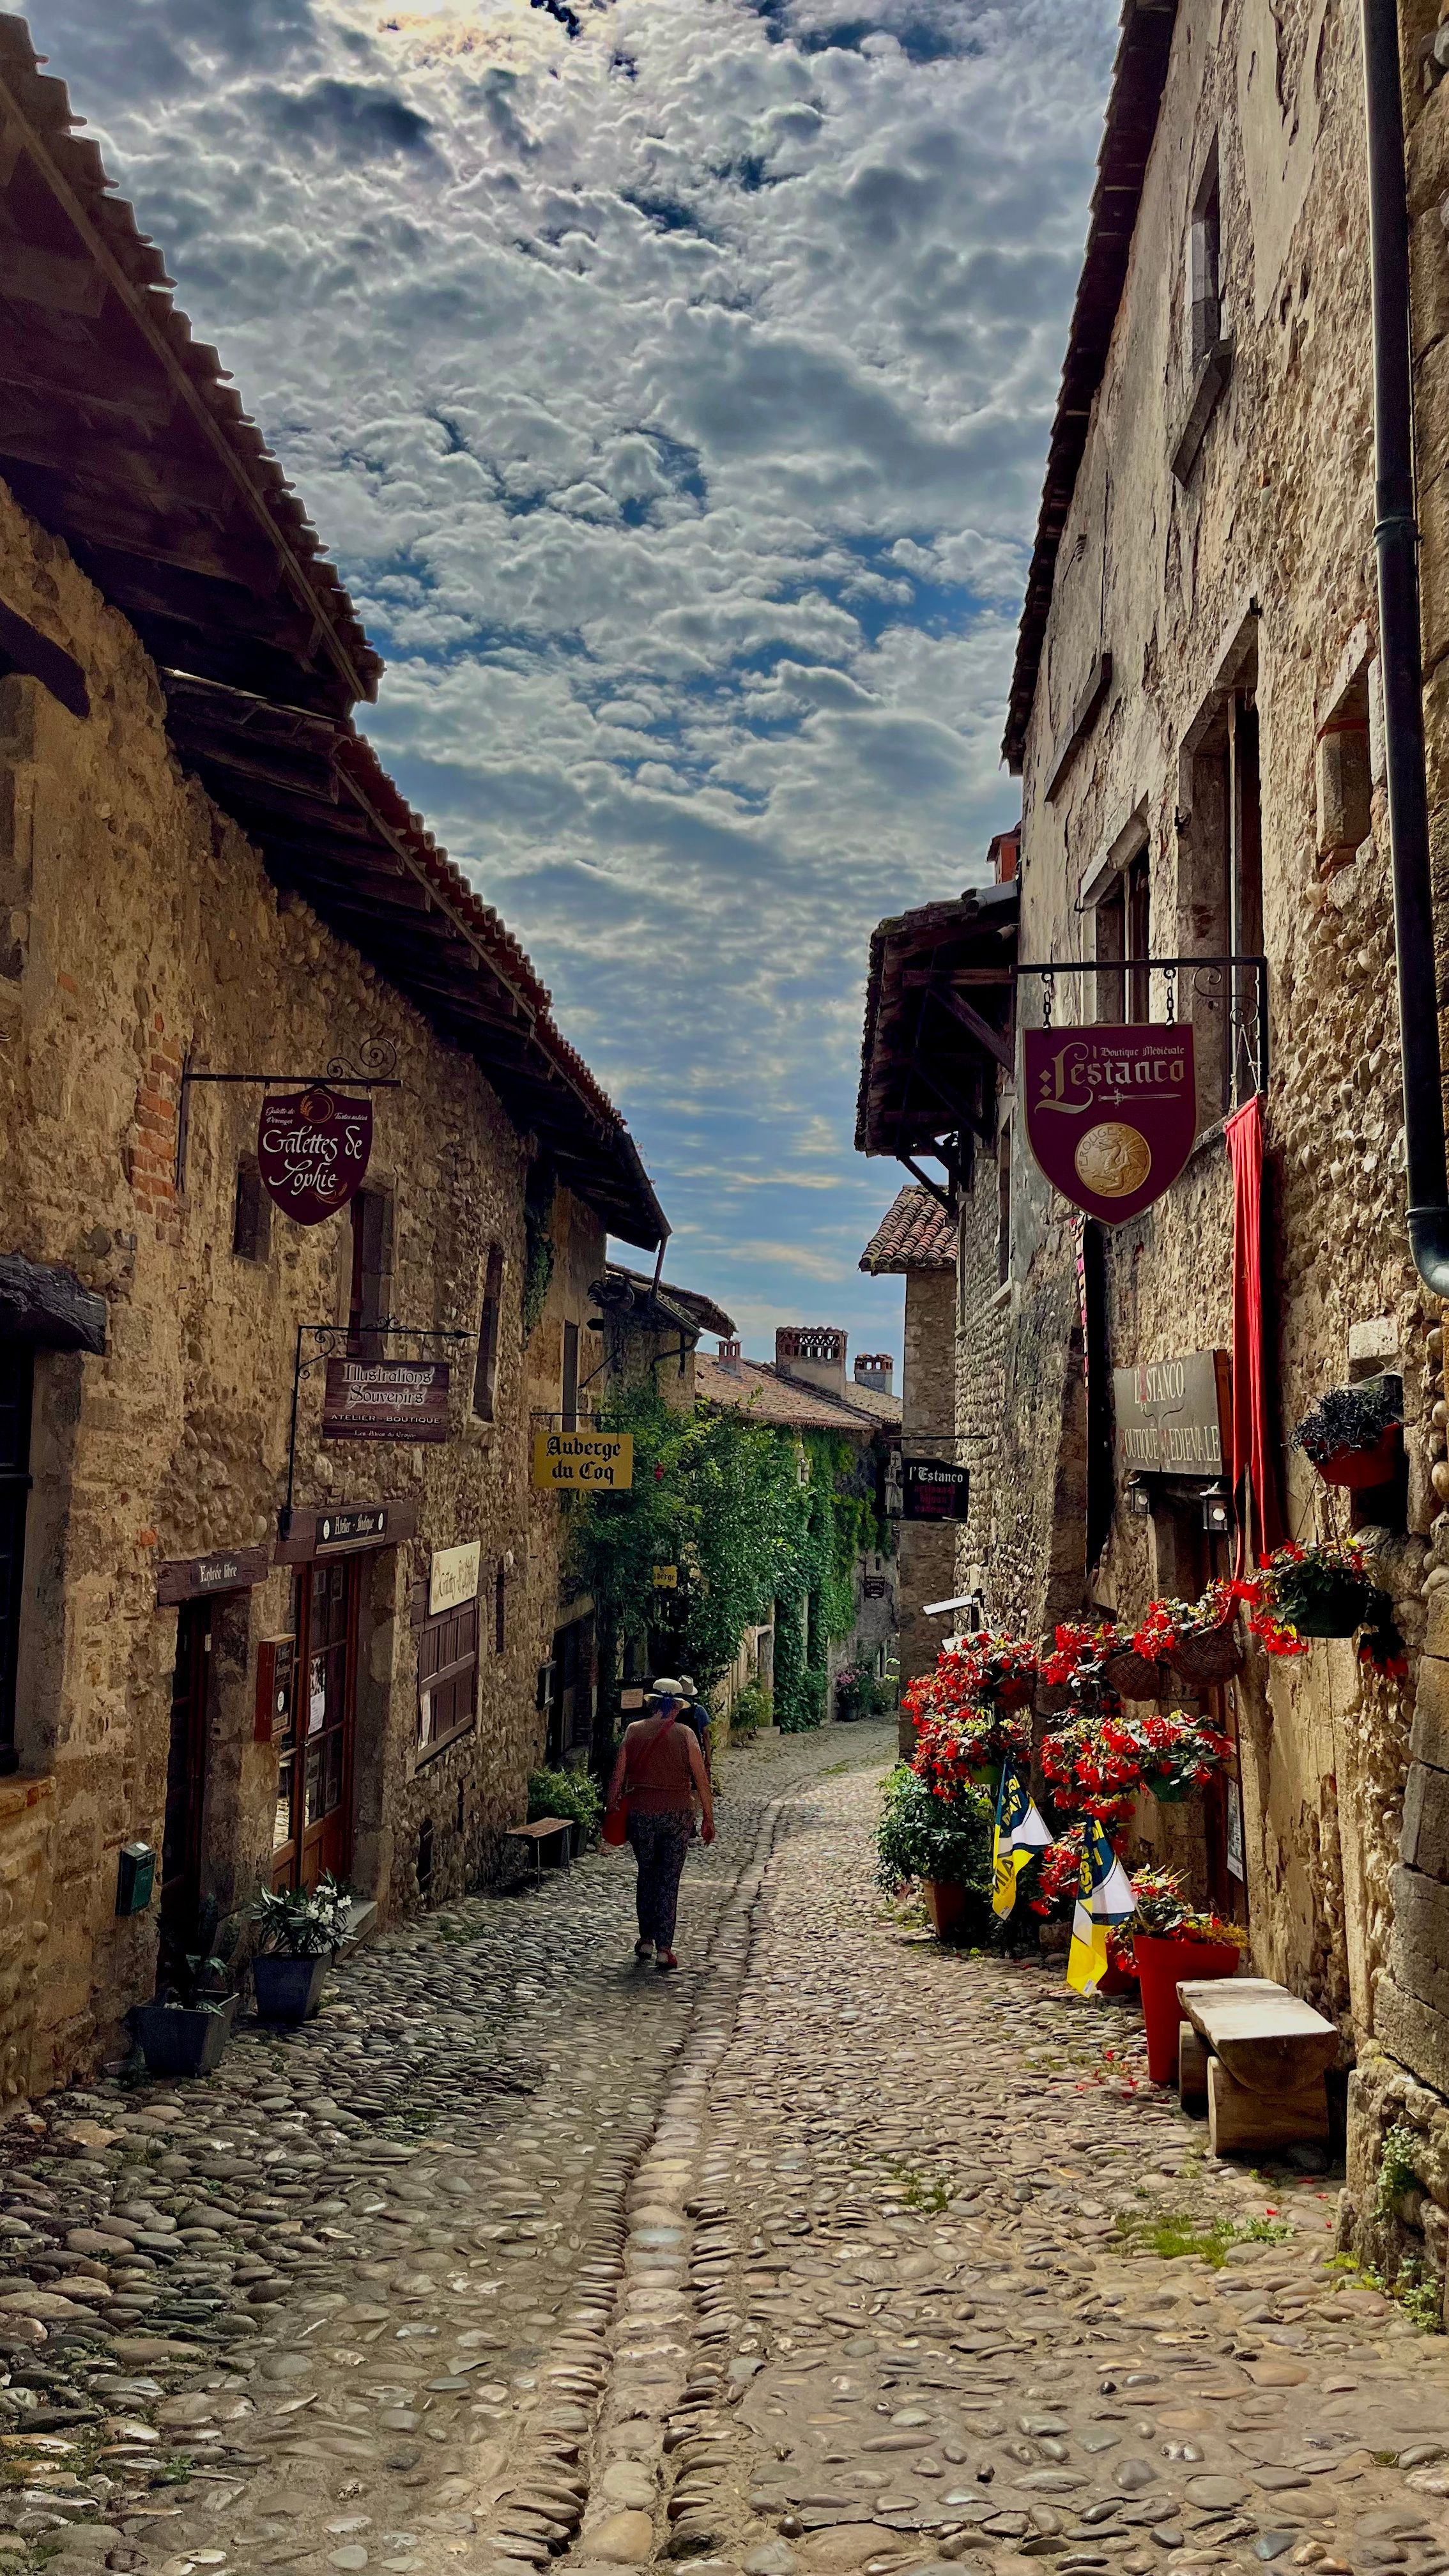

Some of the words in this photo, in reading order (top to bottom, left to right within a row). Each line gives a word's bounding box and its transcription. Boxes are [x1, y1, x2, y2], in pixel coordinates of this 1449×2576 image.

[1100, 1046, 1139, 1058] Boutique
[263, 1125, 339, 1162] Galettes
[345, 1125, 363, 1160] de
[268, 1159, 340, 1195] Sophie
[342, 1363, 435, 1390] Illustrations
[346, 1384, 427, 1411] Souvenirs
[386, 1416, 441, 1424] BOUTIQUE
[546, 1436, 622, 1462] Auberge
[551, 1458, 574, 1480] du
[579, 1460, 615, 1487] Coq
[909, 1466, 963, 1483] l'Estanco
